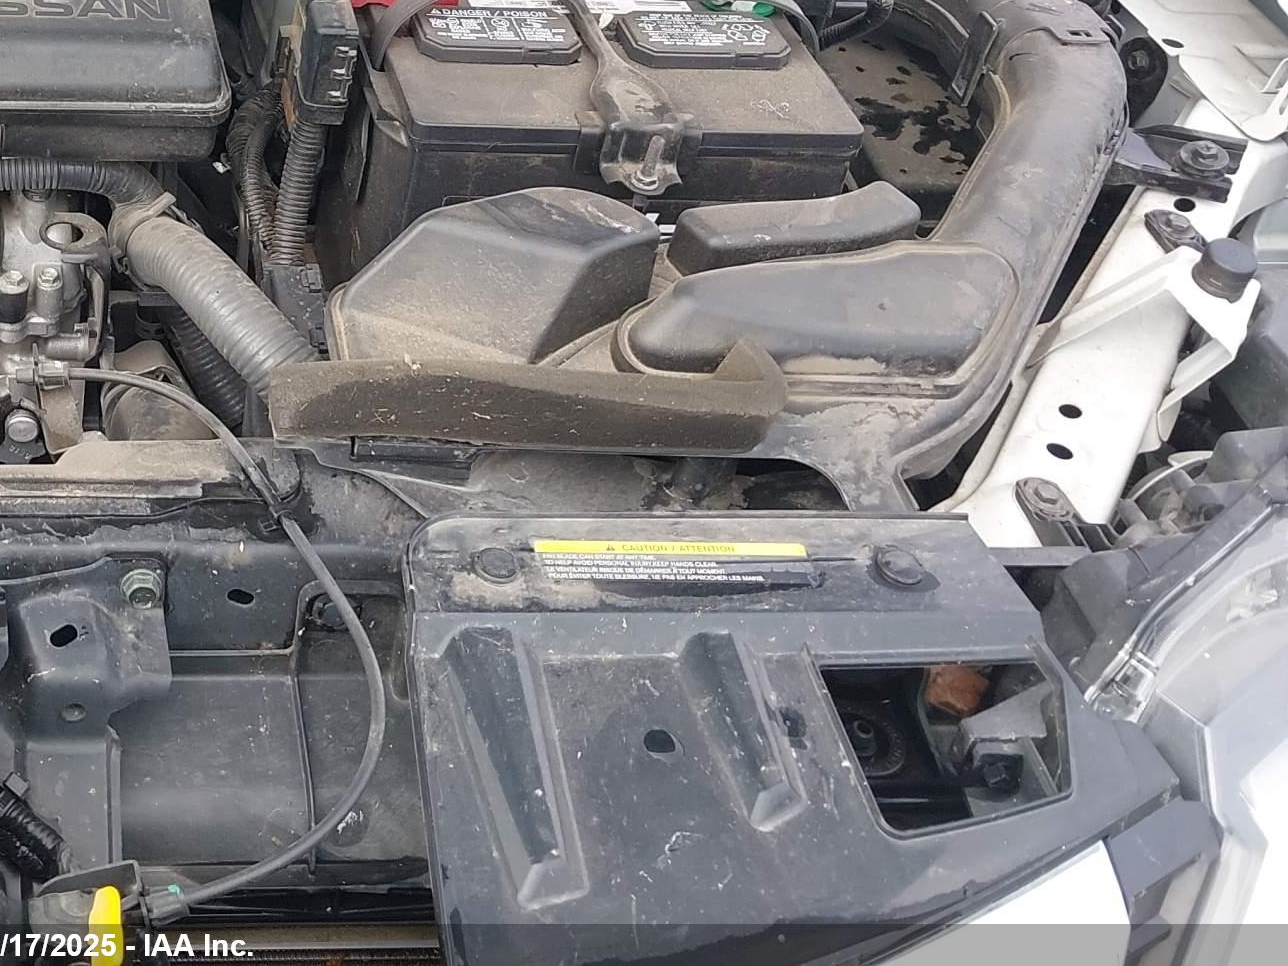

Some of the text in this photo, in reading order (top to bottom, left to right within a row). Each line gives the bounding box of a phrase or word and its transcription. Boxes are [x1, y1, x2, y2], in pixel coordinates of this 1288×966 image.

[440, 8, 491, 16] DANGER
[503, 10, 548, 18] POISON
[621, 544, 668, 552] CAUTION
[679, 545, 736, 553] ATTENTION
